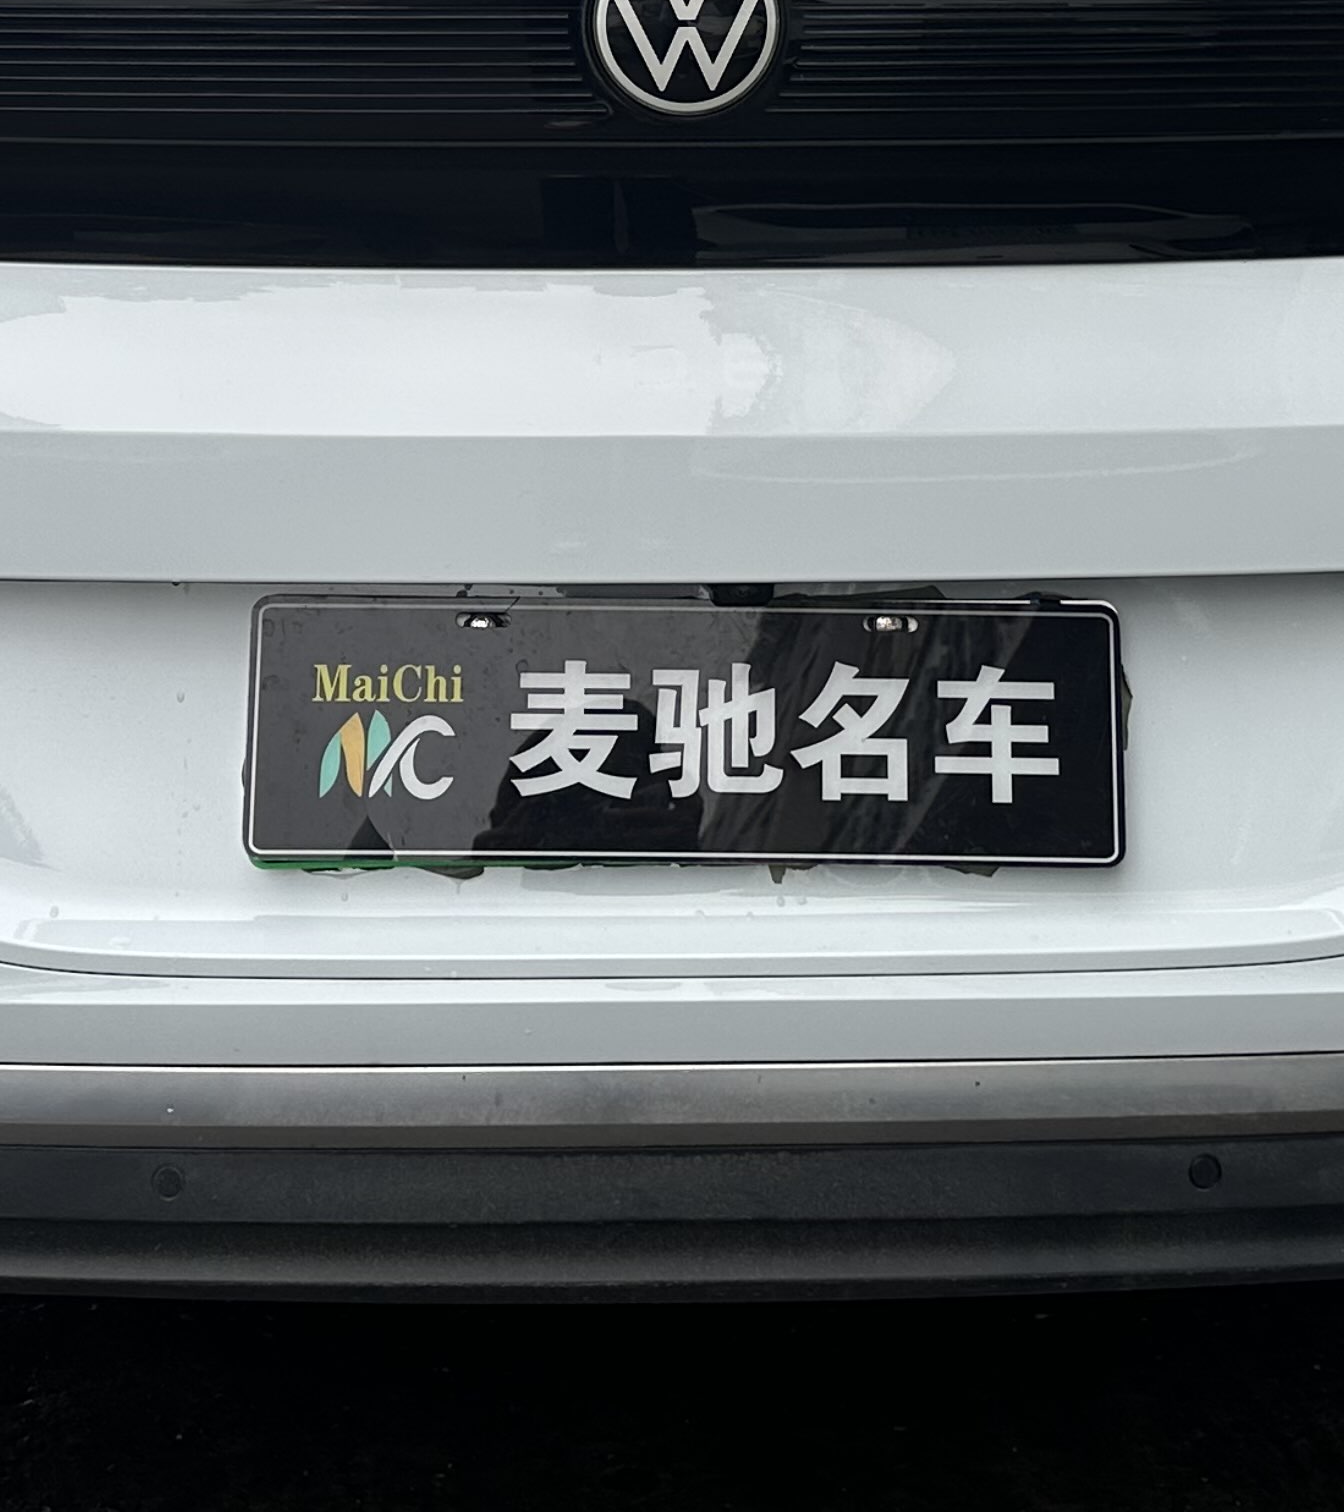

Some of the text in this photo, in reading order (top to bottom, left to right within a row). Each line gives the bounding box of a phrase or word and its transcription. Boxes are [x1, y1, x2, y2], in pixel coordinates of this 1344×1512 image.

[312, 663, 464, 703] MaiChi
[509, 659, 1061, 804] 麦驰名车
